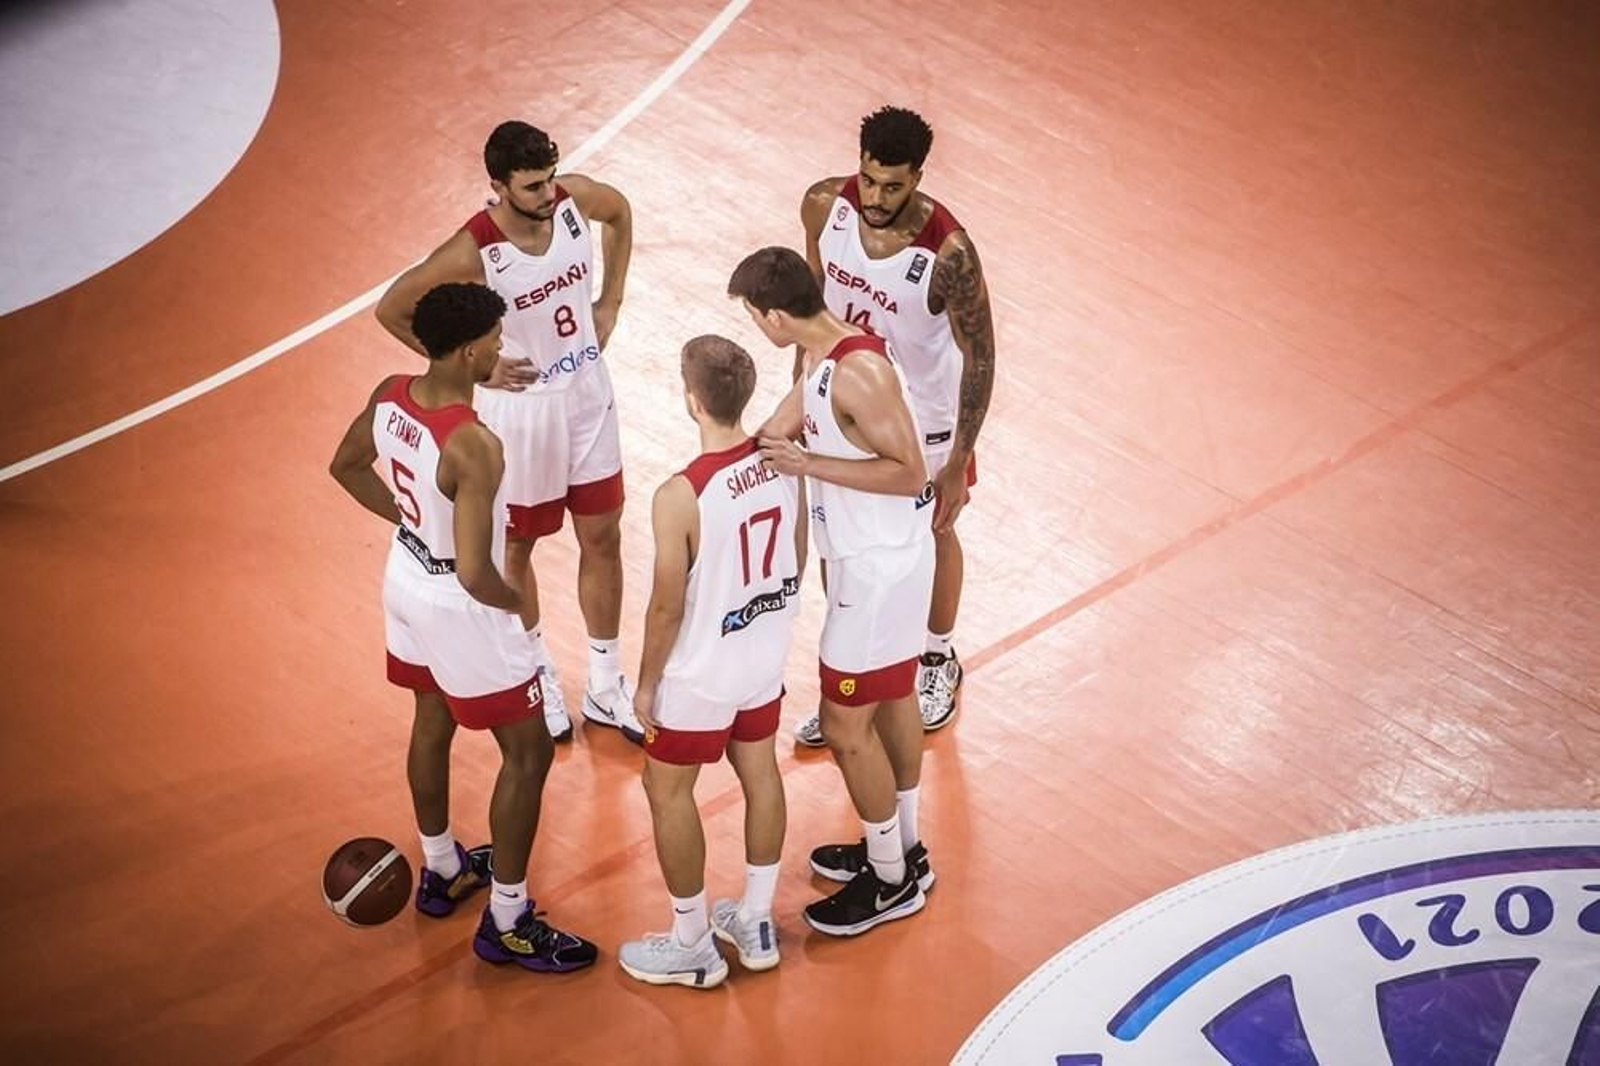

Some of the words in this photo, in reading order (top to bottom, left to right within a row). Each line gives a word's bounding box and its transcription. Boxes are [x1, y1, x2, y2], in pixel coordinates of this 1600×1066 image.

[827, 261, 898, 314] ESPAÑA
[554, 305, 577, 338] 8
[391, 458, 421, 529] 5
[739, 505, 782, 588] 17
